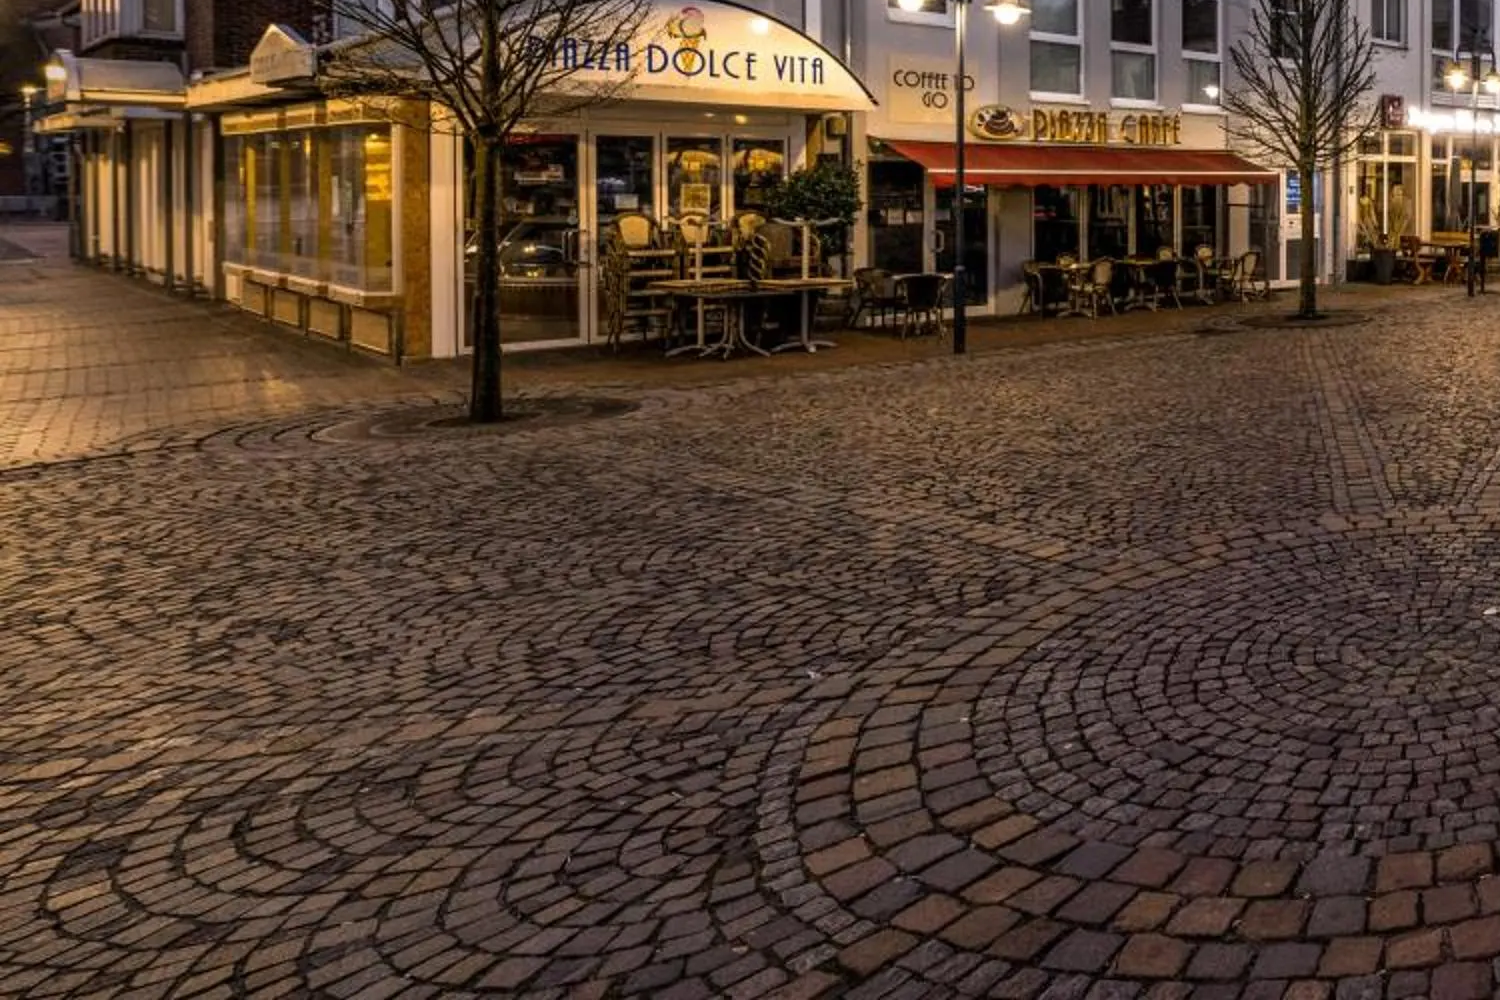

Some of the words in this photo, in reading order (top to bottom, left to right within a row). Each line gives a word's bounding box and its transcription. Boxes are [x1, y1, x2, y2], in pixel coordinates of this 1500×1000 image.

[647, 43, 757, 80] DOLCE
[774, 54, 824, 84] VITA
[893, 69, 948, 89] COFFEE
[922, 92, 948, 109] GO
[1033, 109, 1107, 143] PIAZZA
